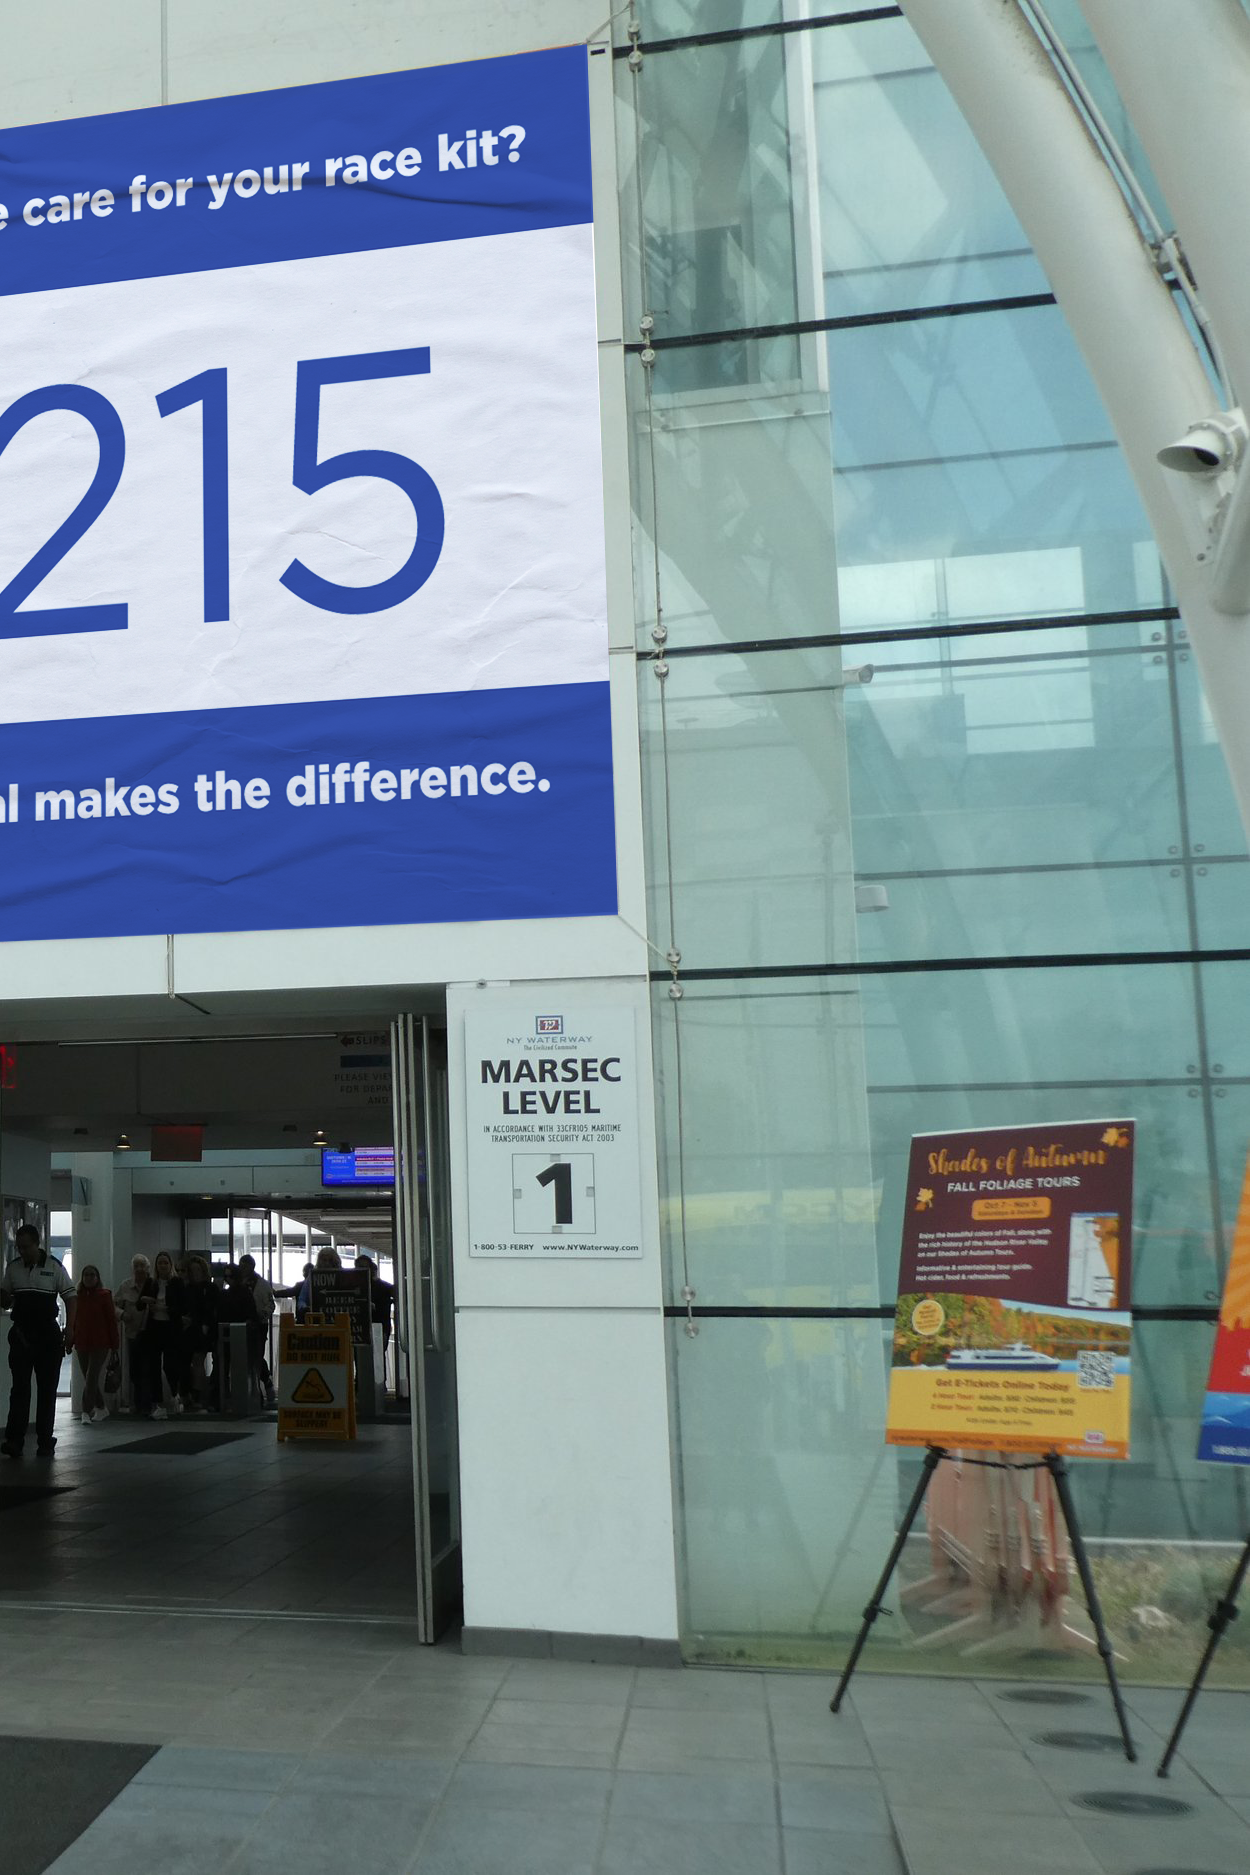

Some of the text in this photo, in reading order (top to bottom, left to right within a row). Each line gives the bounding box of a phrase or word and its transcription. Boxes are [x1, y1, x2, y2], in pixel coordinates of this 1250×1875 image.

[23, 189, 114, 226] care
[129, 175, 193, 212] for
[207, 162, 309, 209] your
[326, 147, 422, 186] race
[438, 125, 525, 171] kit?
[36, 778, 179, 821] makes
[194, 771, 270, 812] the
[287, 761, 550, 806] difference.
[527, 1036, 592, 1044] WATERWAY
[481, 1057, 621, 1083] MARSEC
[503, 1090, 601, 1114] LEVEL
[484, 1125, 490, 1133] IN
[493, 1125, 535, 1133] ACCORDANCE
[557, 1124, 588, 1132] 33CFR105
[591, 1124, 621, 1132] MARITIME
[548, 1134, 579, 1142] SECURITY
[582, 1134, 593, 1142] ACT
[597, 1134, 614, 1142] 2003
[928, 1144, 1107, 1176] Shades of Autumn
[535, 1163, 573, 1224] 1
[947, 1176, 1081, 1193] FALL FOLIAGE TOURS
[543, 1244, 639, 1252] www.NYWaterway.com
[287, 1333, 340, 1350] Caution
